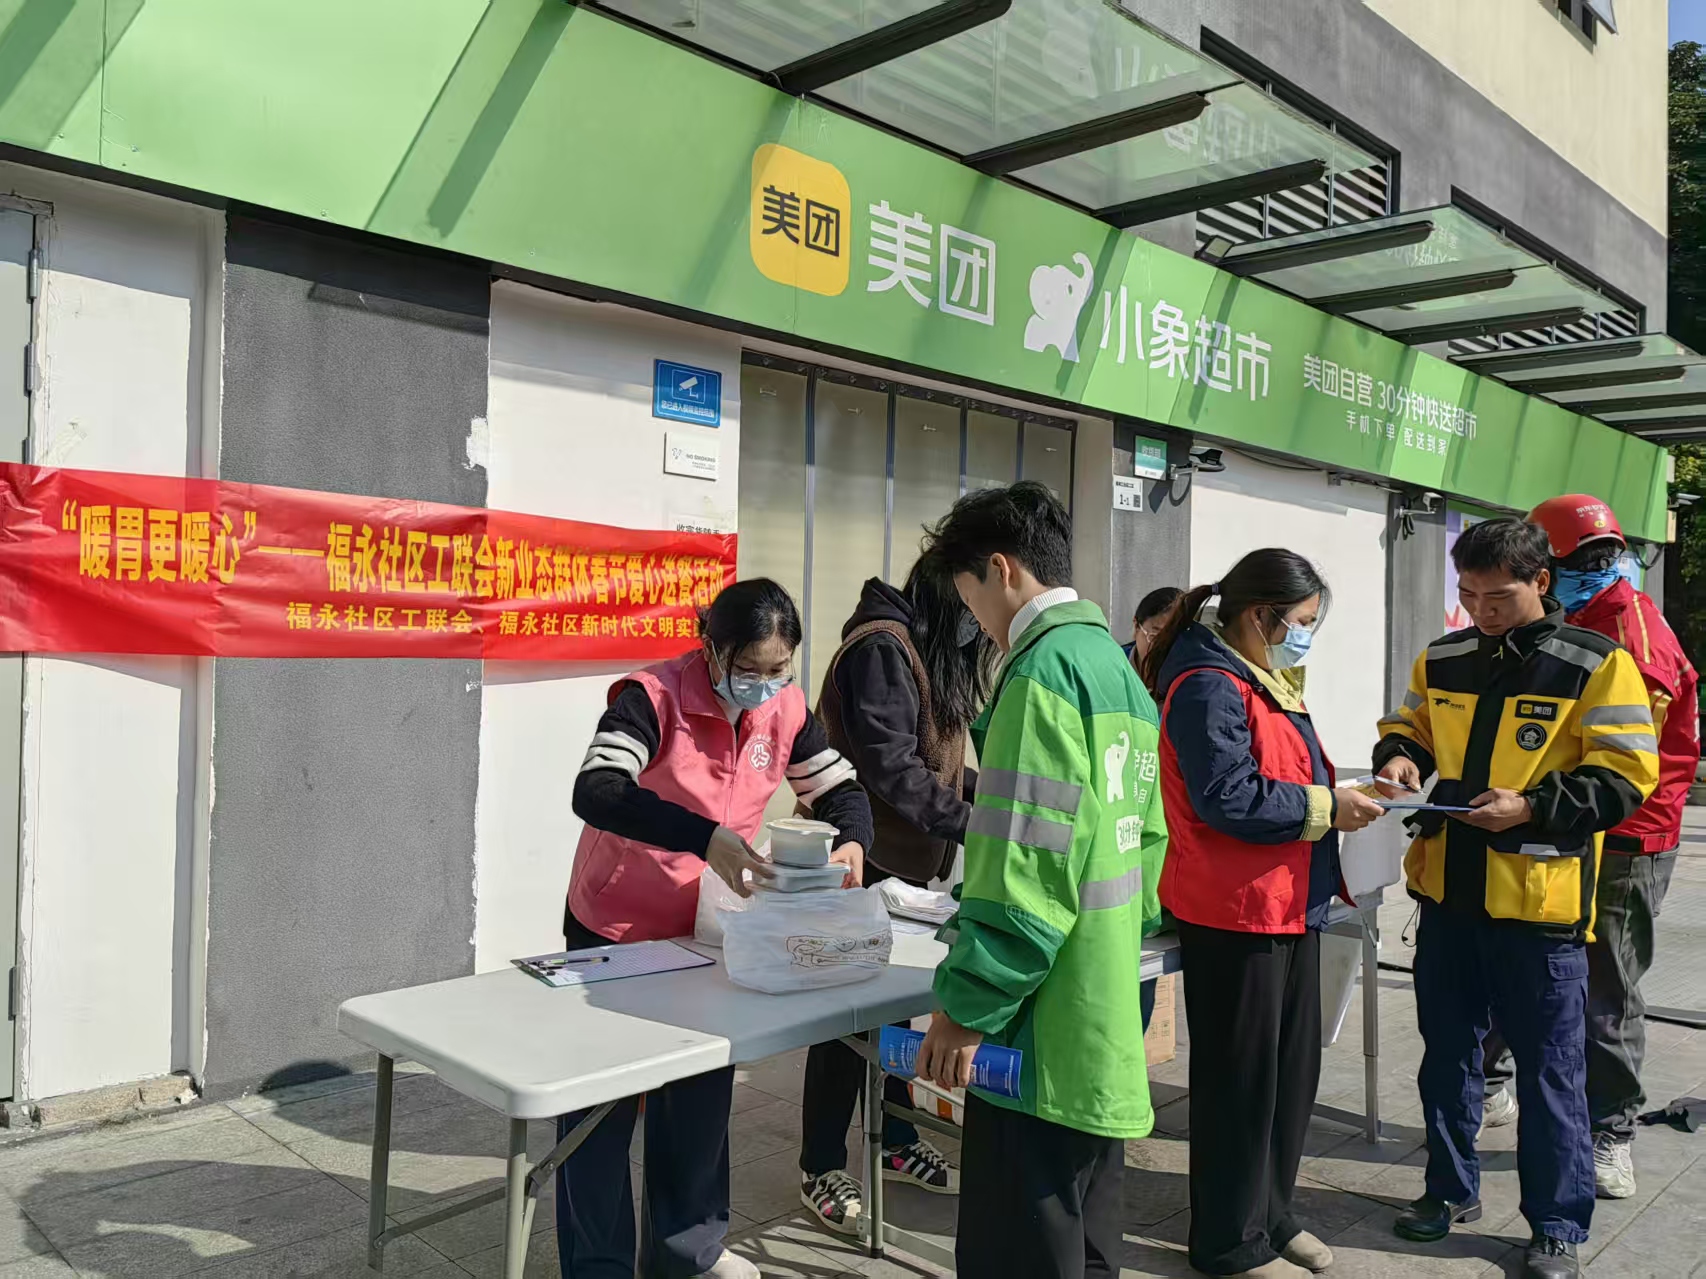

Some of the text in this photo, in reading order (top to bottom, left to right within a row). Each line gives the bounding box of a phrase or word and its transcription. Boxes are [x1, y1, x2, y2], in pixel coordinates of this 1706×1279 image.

[760, 184, 841, 257] 美团
[867, 199, 1272, 401] 美团 小象超市
[1303, 353, 1478, 440] 美团自营 30分钟快送超市
[1345, 410, 1447, 457] 手机下单 配送到家
